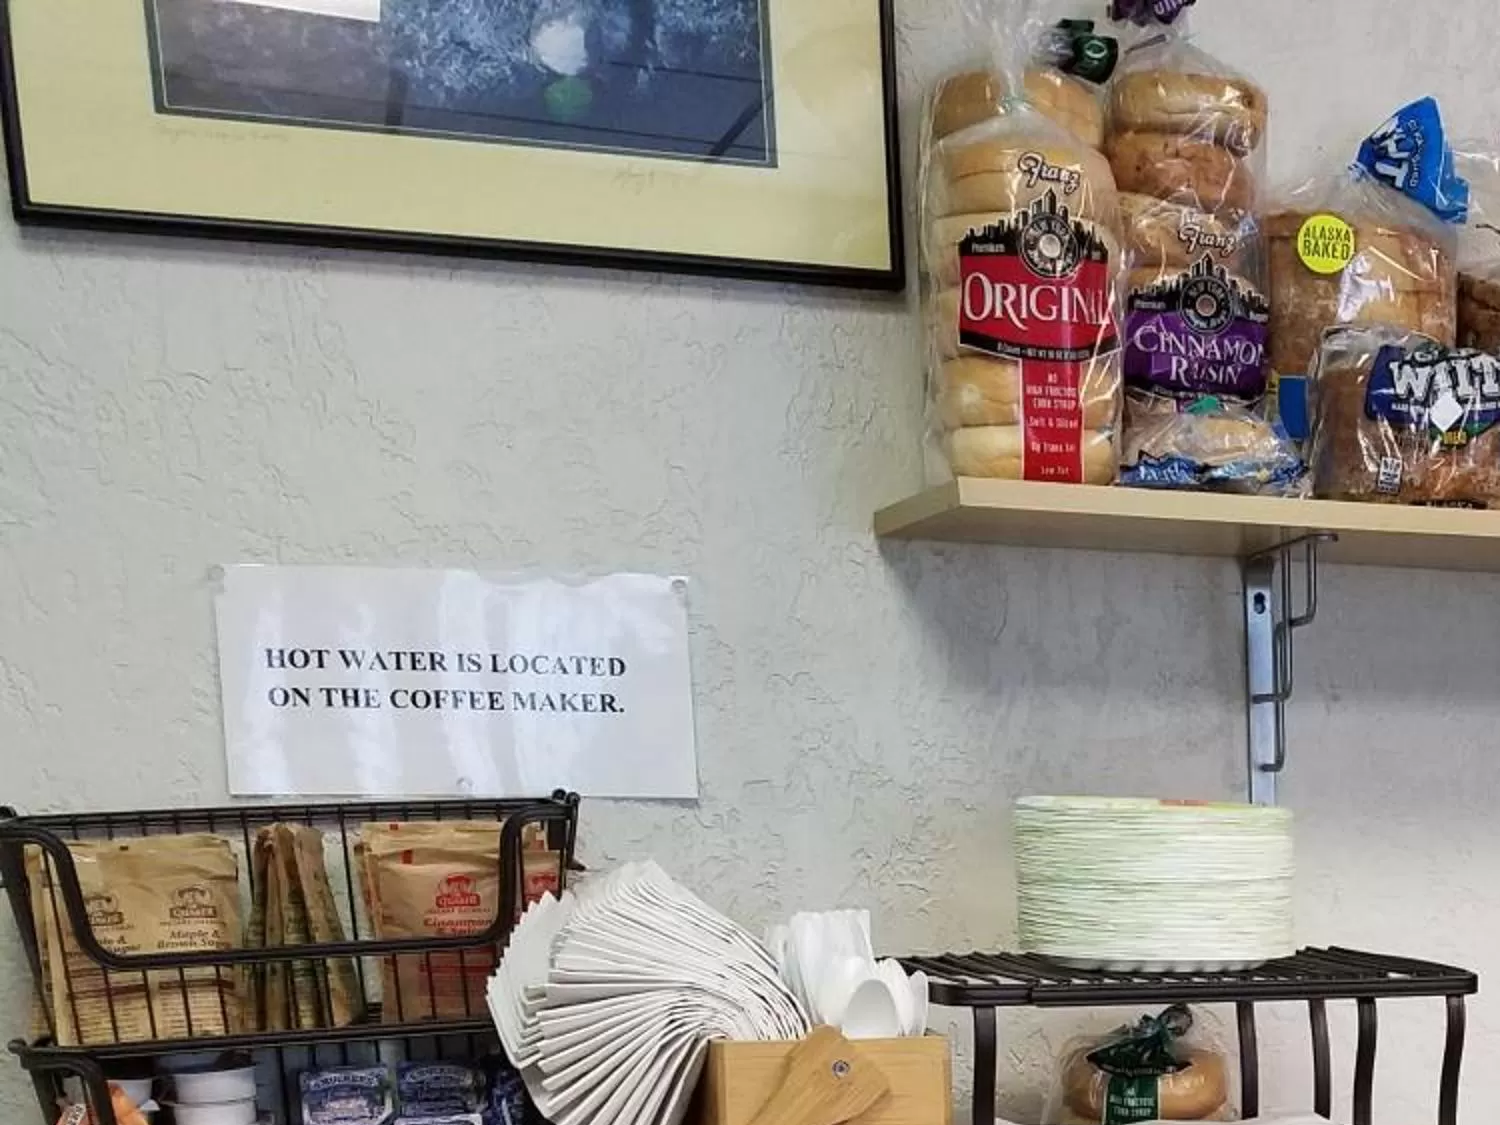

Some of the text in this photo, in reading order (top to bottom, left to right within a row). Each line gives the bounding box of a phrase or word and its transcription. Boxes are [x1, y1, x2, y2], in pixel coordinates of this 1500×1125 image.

[1303, 226, 1351, 243] ALASKA
[1302, 239, 1351, 261] BAKED
[265, 648, 627, 677] HOT WATER IS LOCATED
[267, 687, 626, 714] ON THE COFFEE MAKER.
